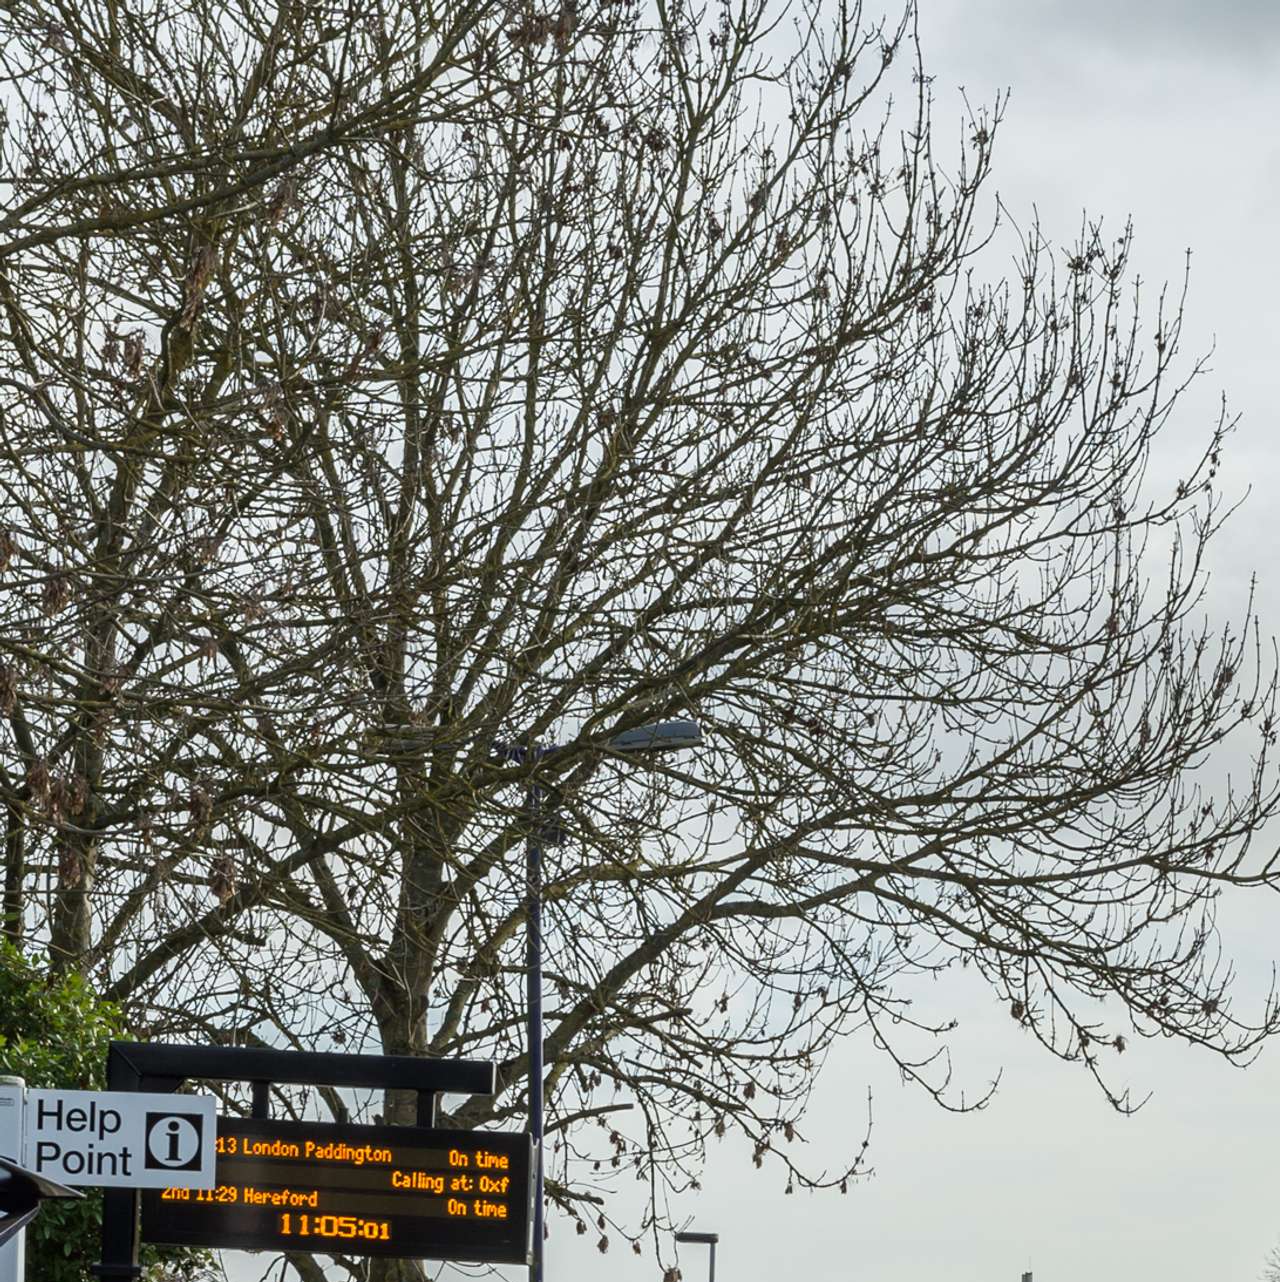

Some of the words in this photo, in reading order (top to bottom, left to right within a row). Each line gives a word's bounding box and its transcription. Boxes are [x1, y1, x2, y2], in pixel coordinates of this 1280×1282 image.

[37, 1099, 122, 1140] Help
[36, 1141, 132, 1176] Point
[215, 1136, 238, 1154] :13
[243, 1138, 299, 1157] London
[305, 1141, 392, 1165] Paddington
[449, 1149, 468, 1167] On
[475, 1151, 509, 1169] time
[392, 1171, 444, 1194] Calling
[450, 1174, 474, 1191] at:
[480, 1175, 510, 1193] Oxf
[196, 1186, 238, 1202] 11:29
[244, 1188, 318, 1208] Hereford
[447, 1199, 467, 1216] On
[474, 1200, 507, 1218] time
